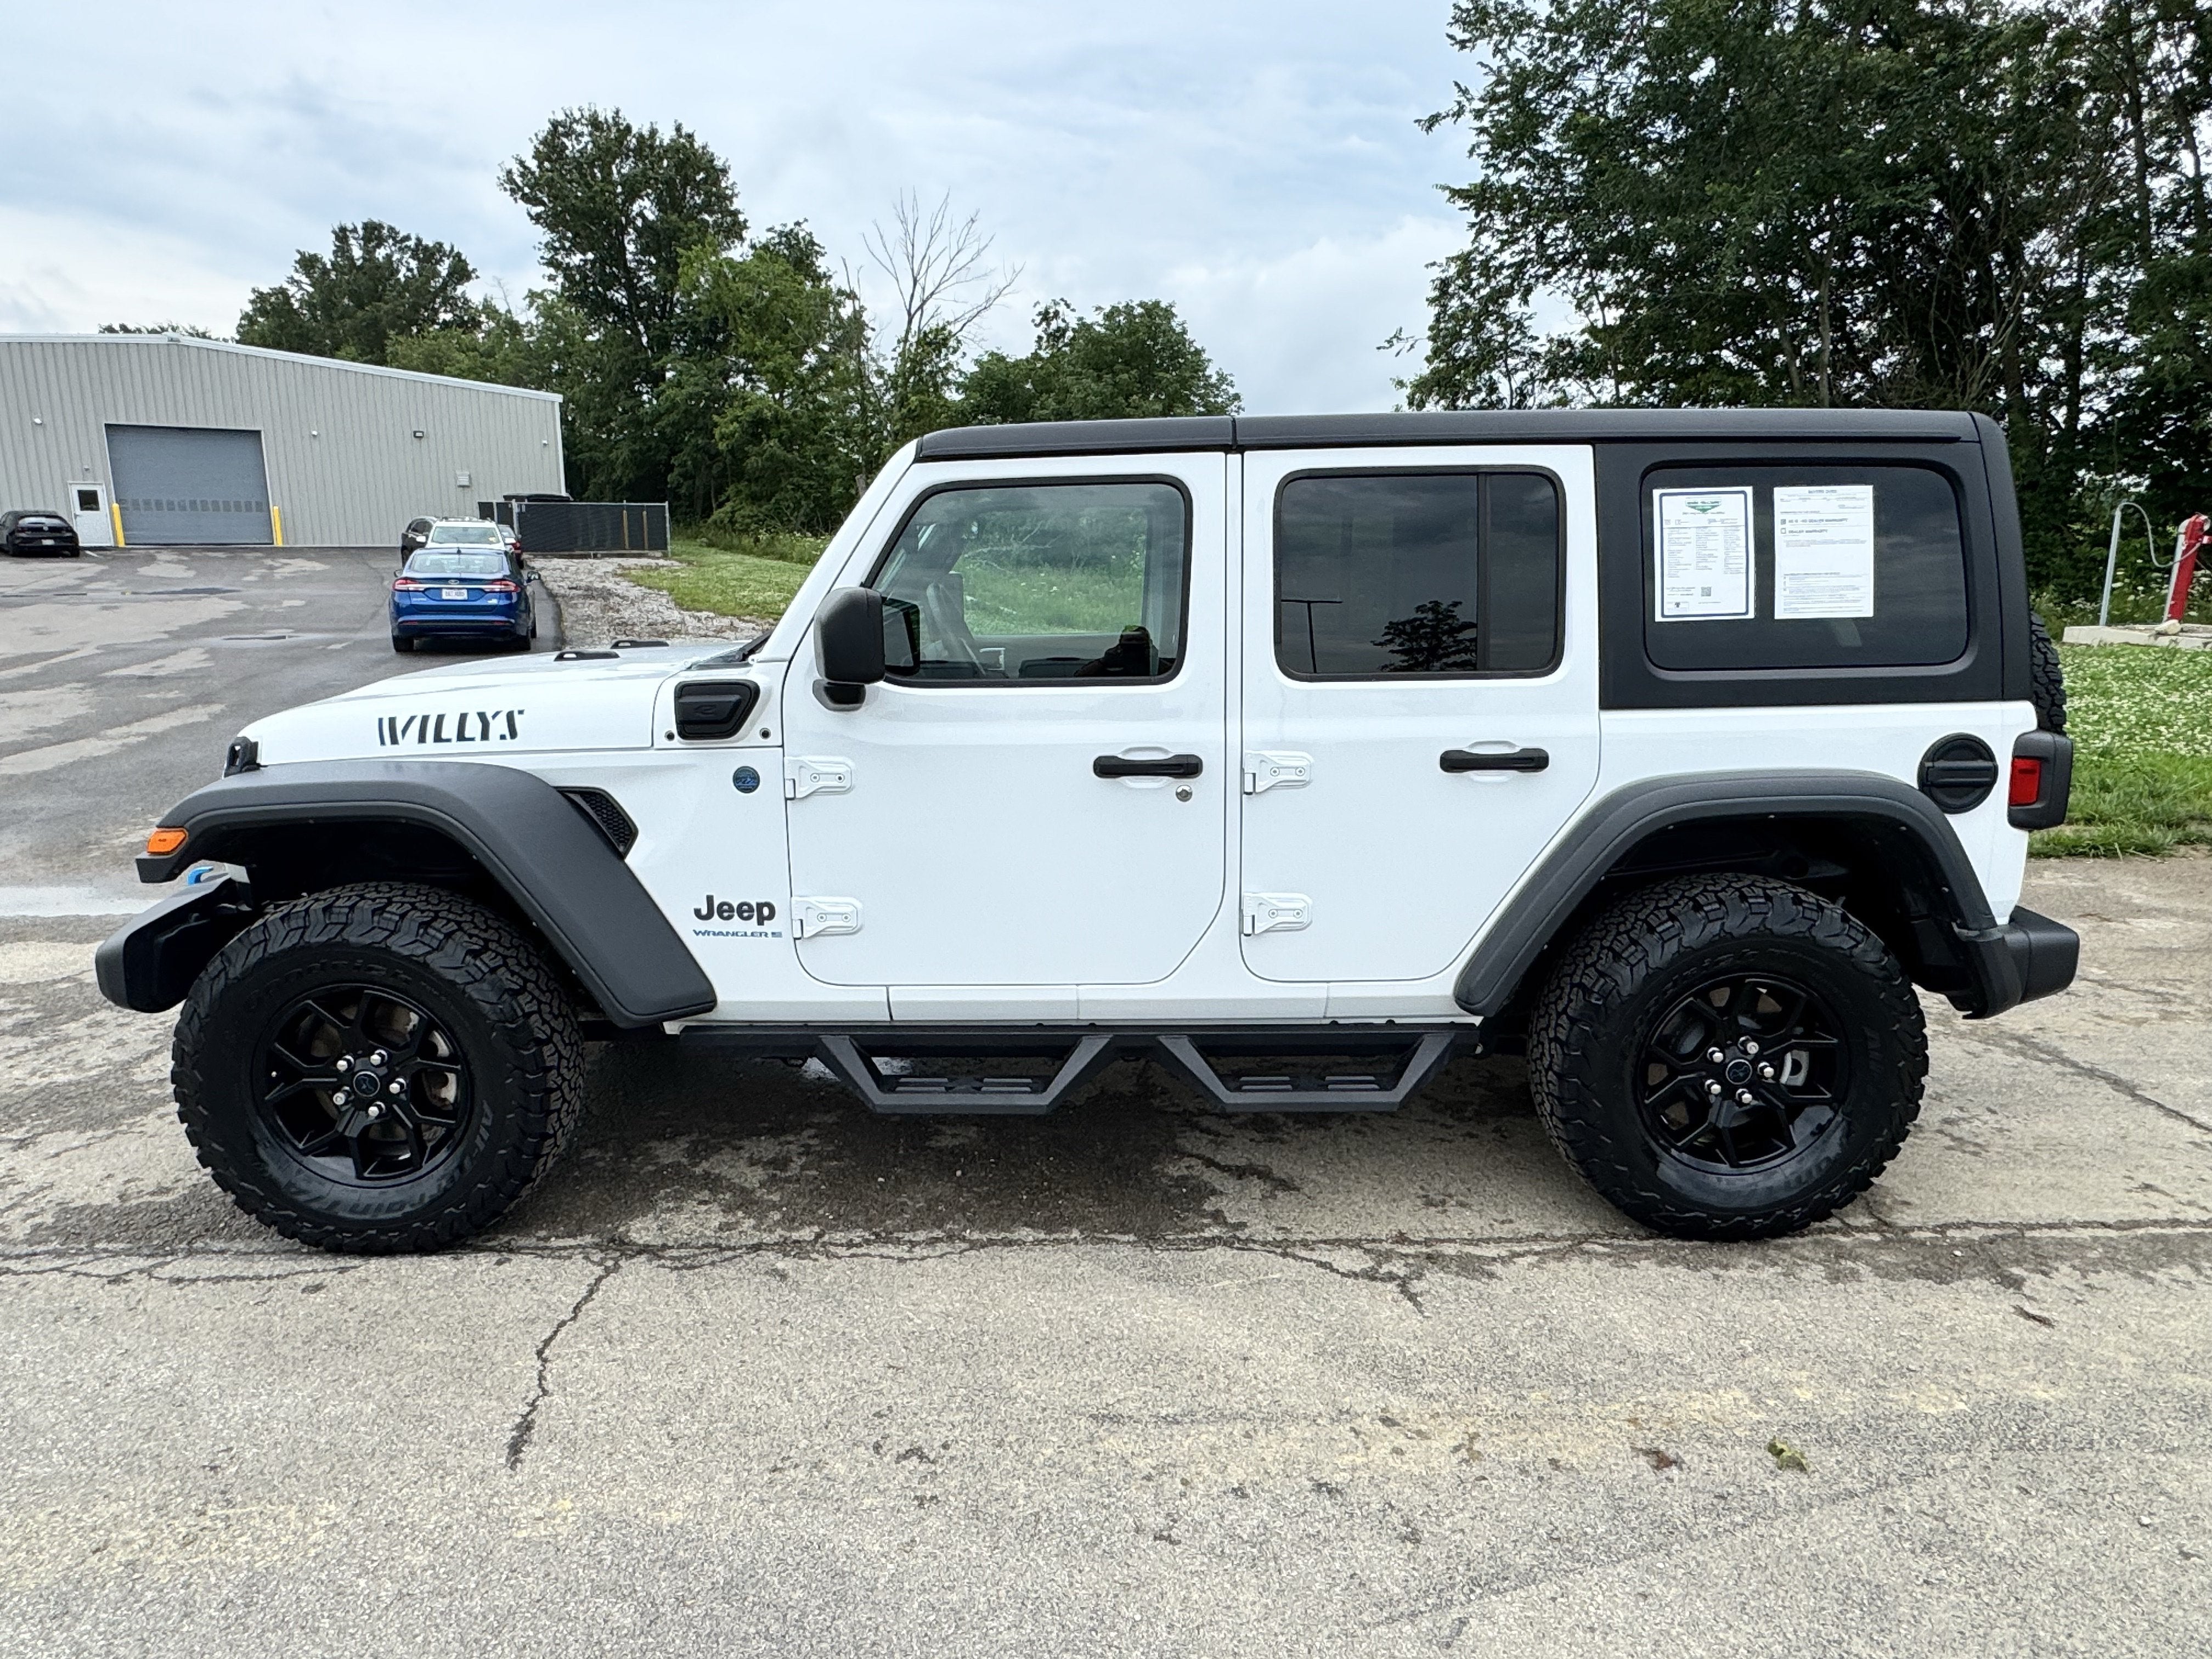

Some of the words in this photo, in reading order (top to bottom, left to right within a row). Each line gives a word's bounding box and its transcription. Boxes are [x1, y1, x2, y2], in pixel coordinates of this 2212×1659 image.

[378, 709, 526, 746] WILLYS
[693, 894, 776, 926] Jeep
[692, 929, 769, 938] WRANGLER
